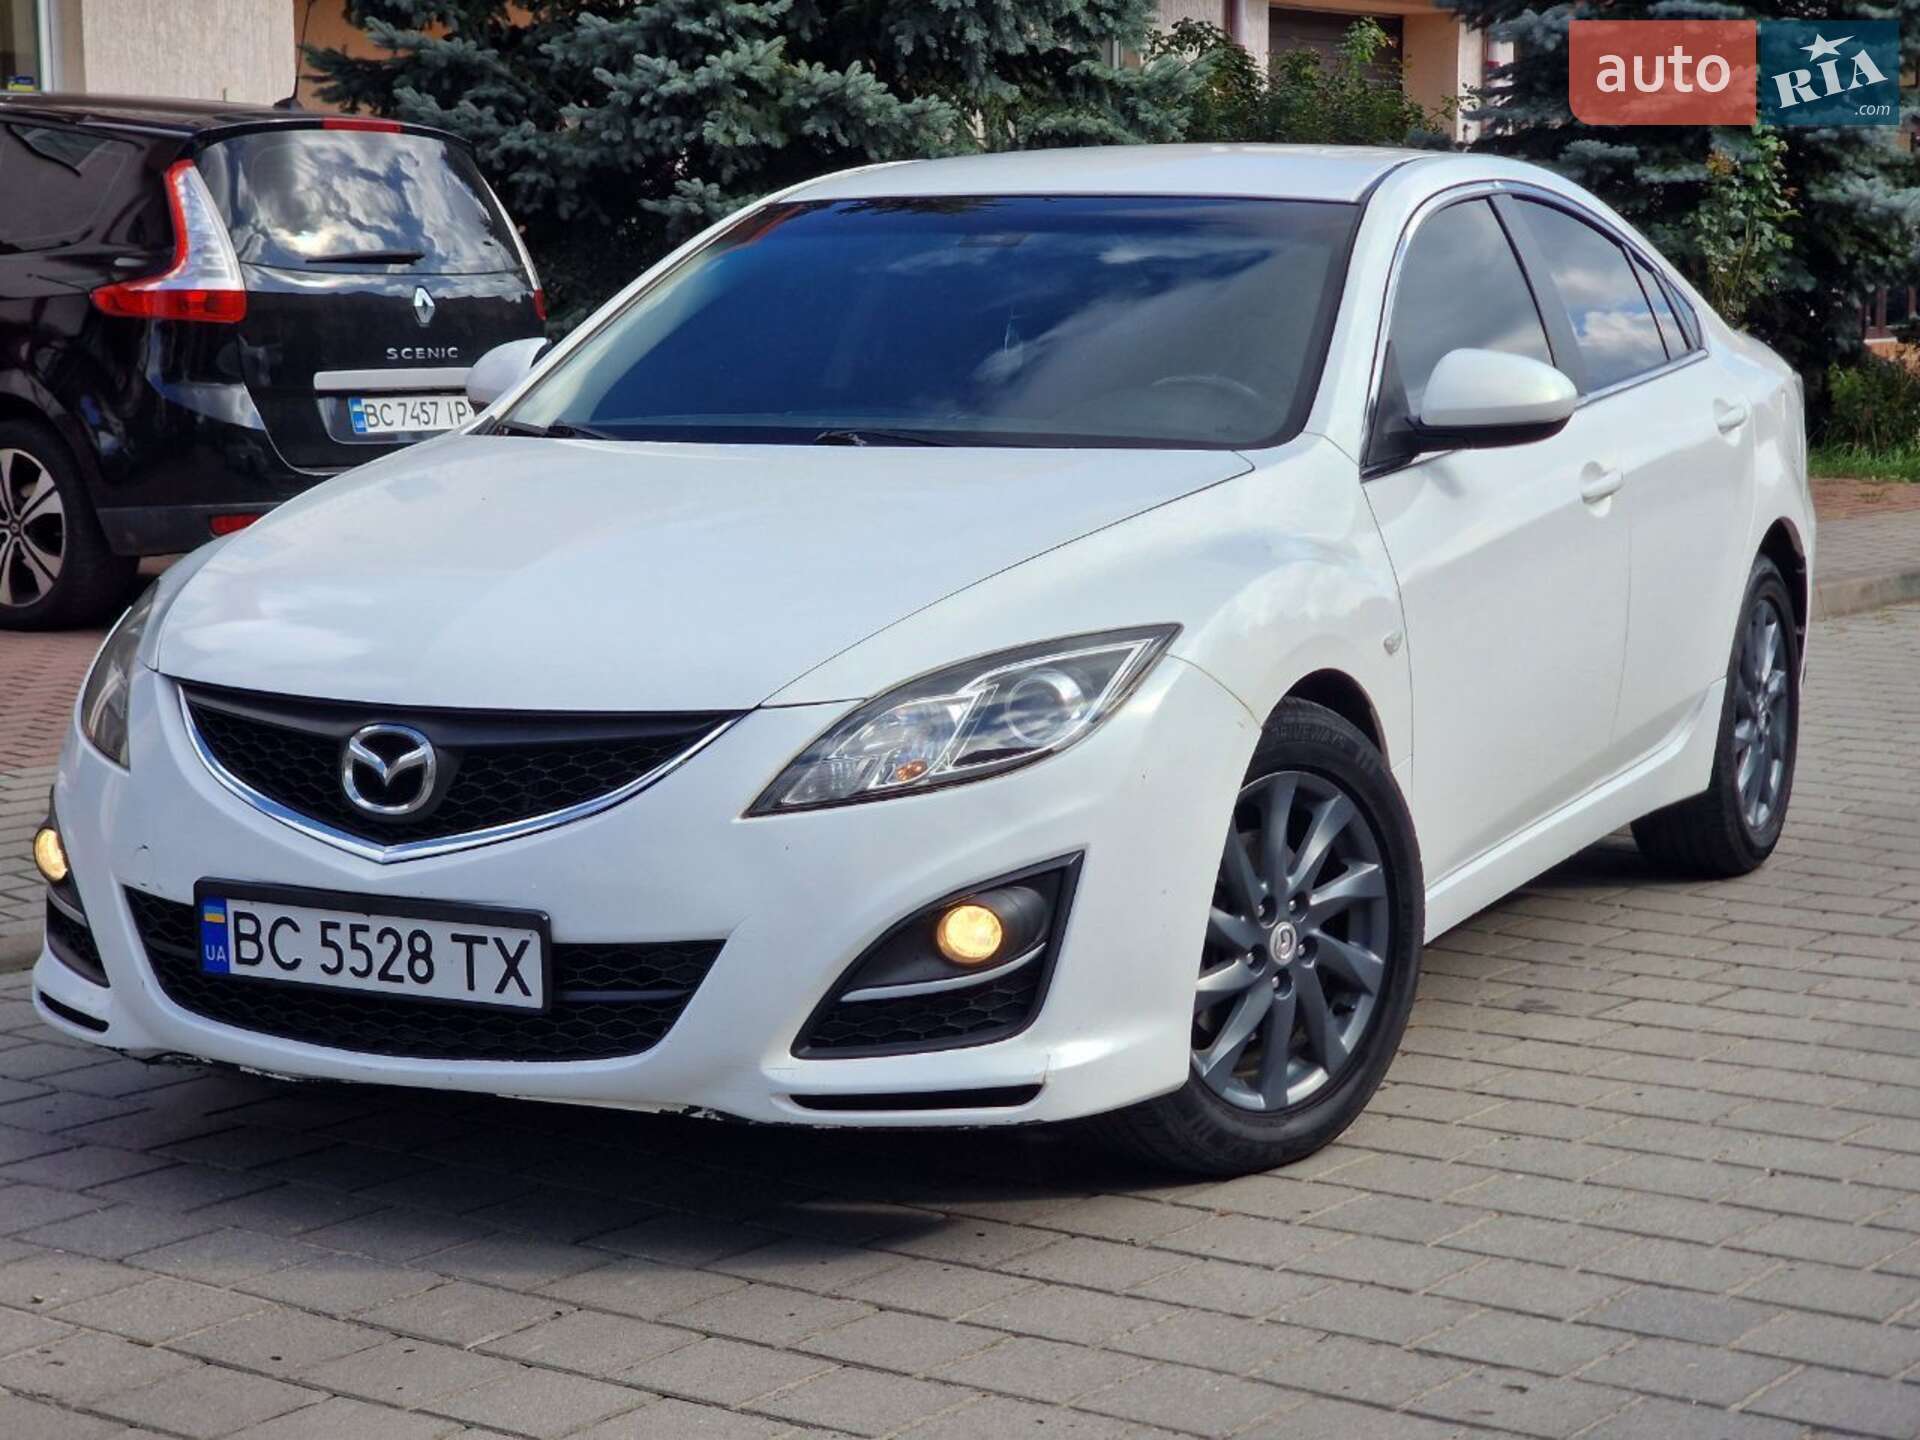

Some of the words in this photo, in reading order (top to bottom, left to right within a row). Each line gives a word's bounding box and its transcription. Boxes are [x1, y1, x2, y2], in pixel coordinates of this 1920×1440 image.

[386, 347, 458, 360] SCENIC
[364, 404, 394, 428] BC
[397, 401, 439, 425] 7457
[204, 944, 227, 963] UA
[232, 911, 302, 971] BC
[319, 920, 435, 984] 5528
[450, 933, 532, 997] TX
